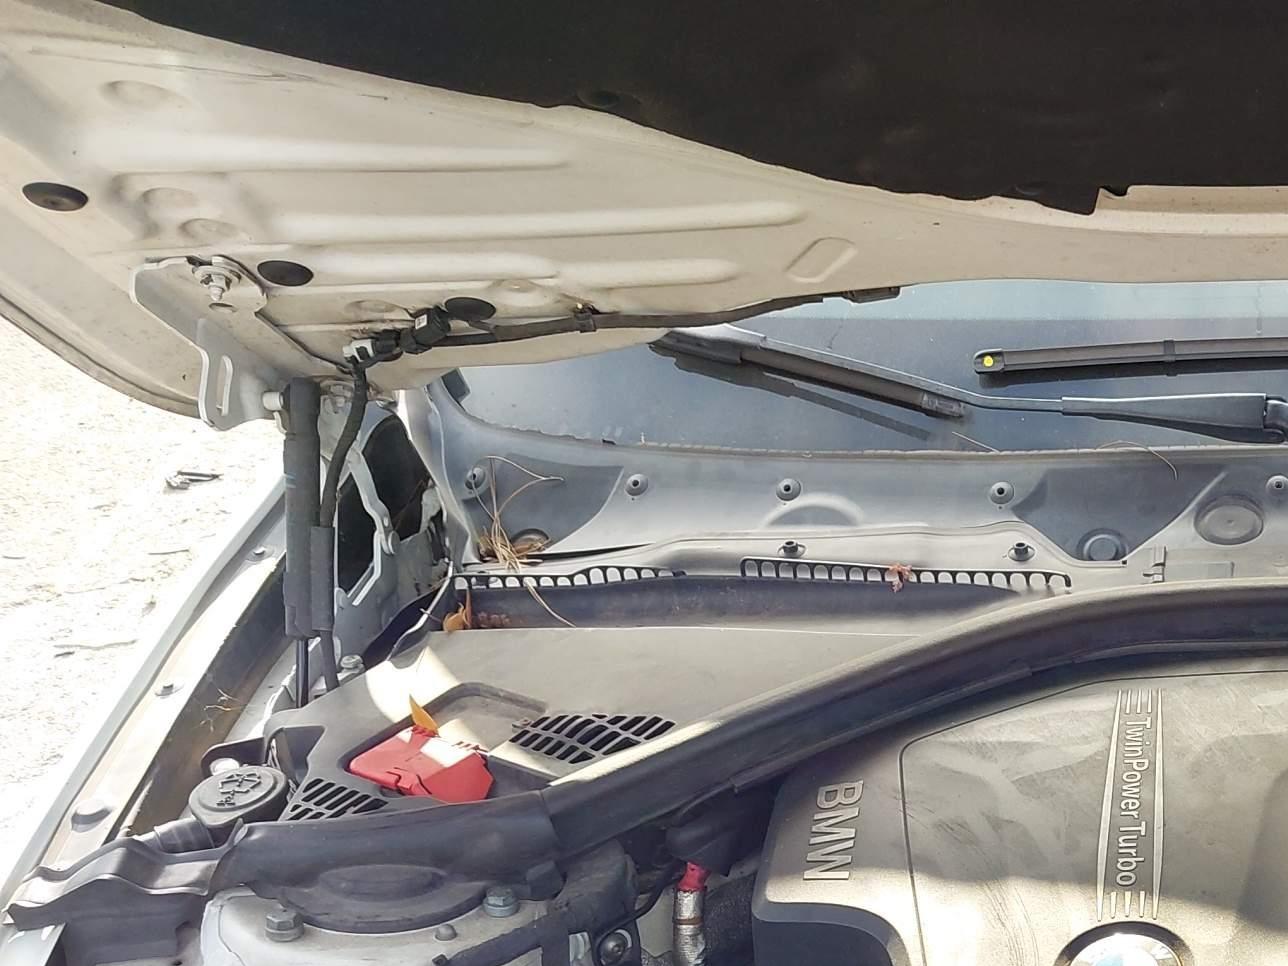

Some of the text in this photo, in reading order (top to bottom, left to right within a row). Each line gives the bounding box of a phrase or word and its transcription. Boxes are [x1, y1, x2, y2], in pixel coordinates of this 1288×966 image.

[803, 780, 864, 880] BMW
[1115, 716, 1152, 887] TwinPower Turbo
